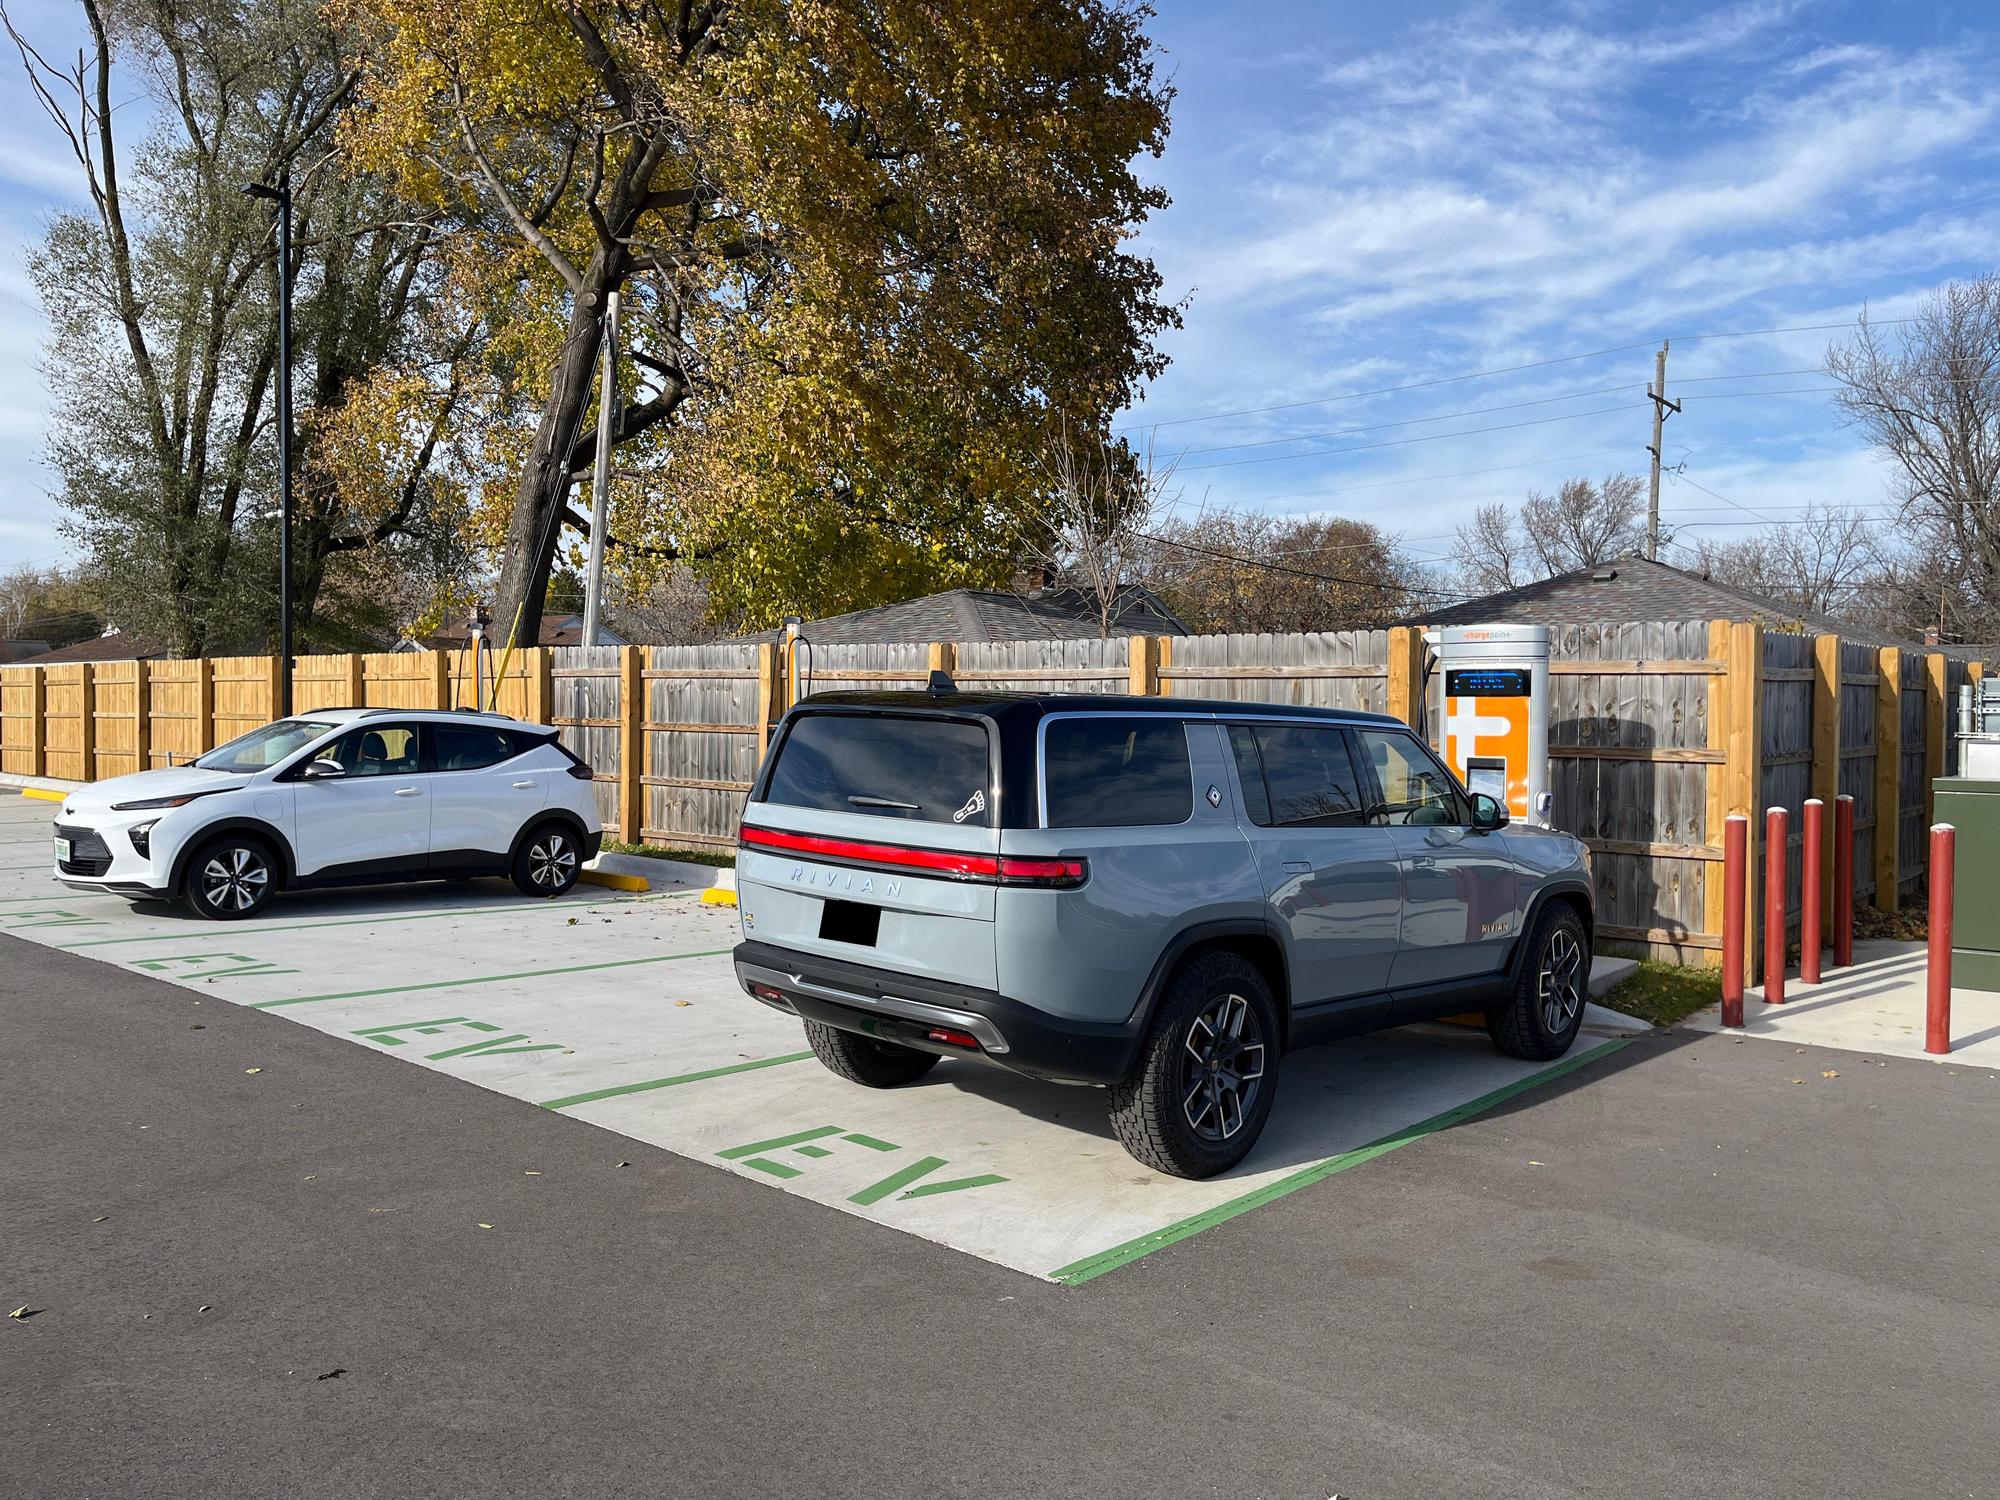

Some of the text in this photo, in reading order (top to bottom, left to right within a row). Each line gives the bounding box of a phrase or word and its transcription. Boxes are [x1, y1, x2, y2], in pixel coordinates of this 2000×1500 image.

[791, 864, 902, 898] RIVIAN
[1481, 922, 1509, 934] RIVIAN
[127, 952, 302, 980] EV
[350, 1016, 566, 1061] EV
[713, 1125, 1012, 1206] EV
